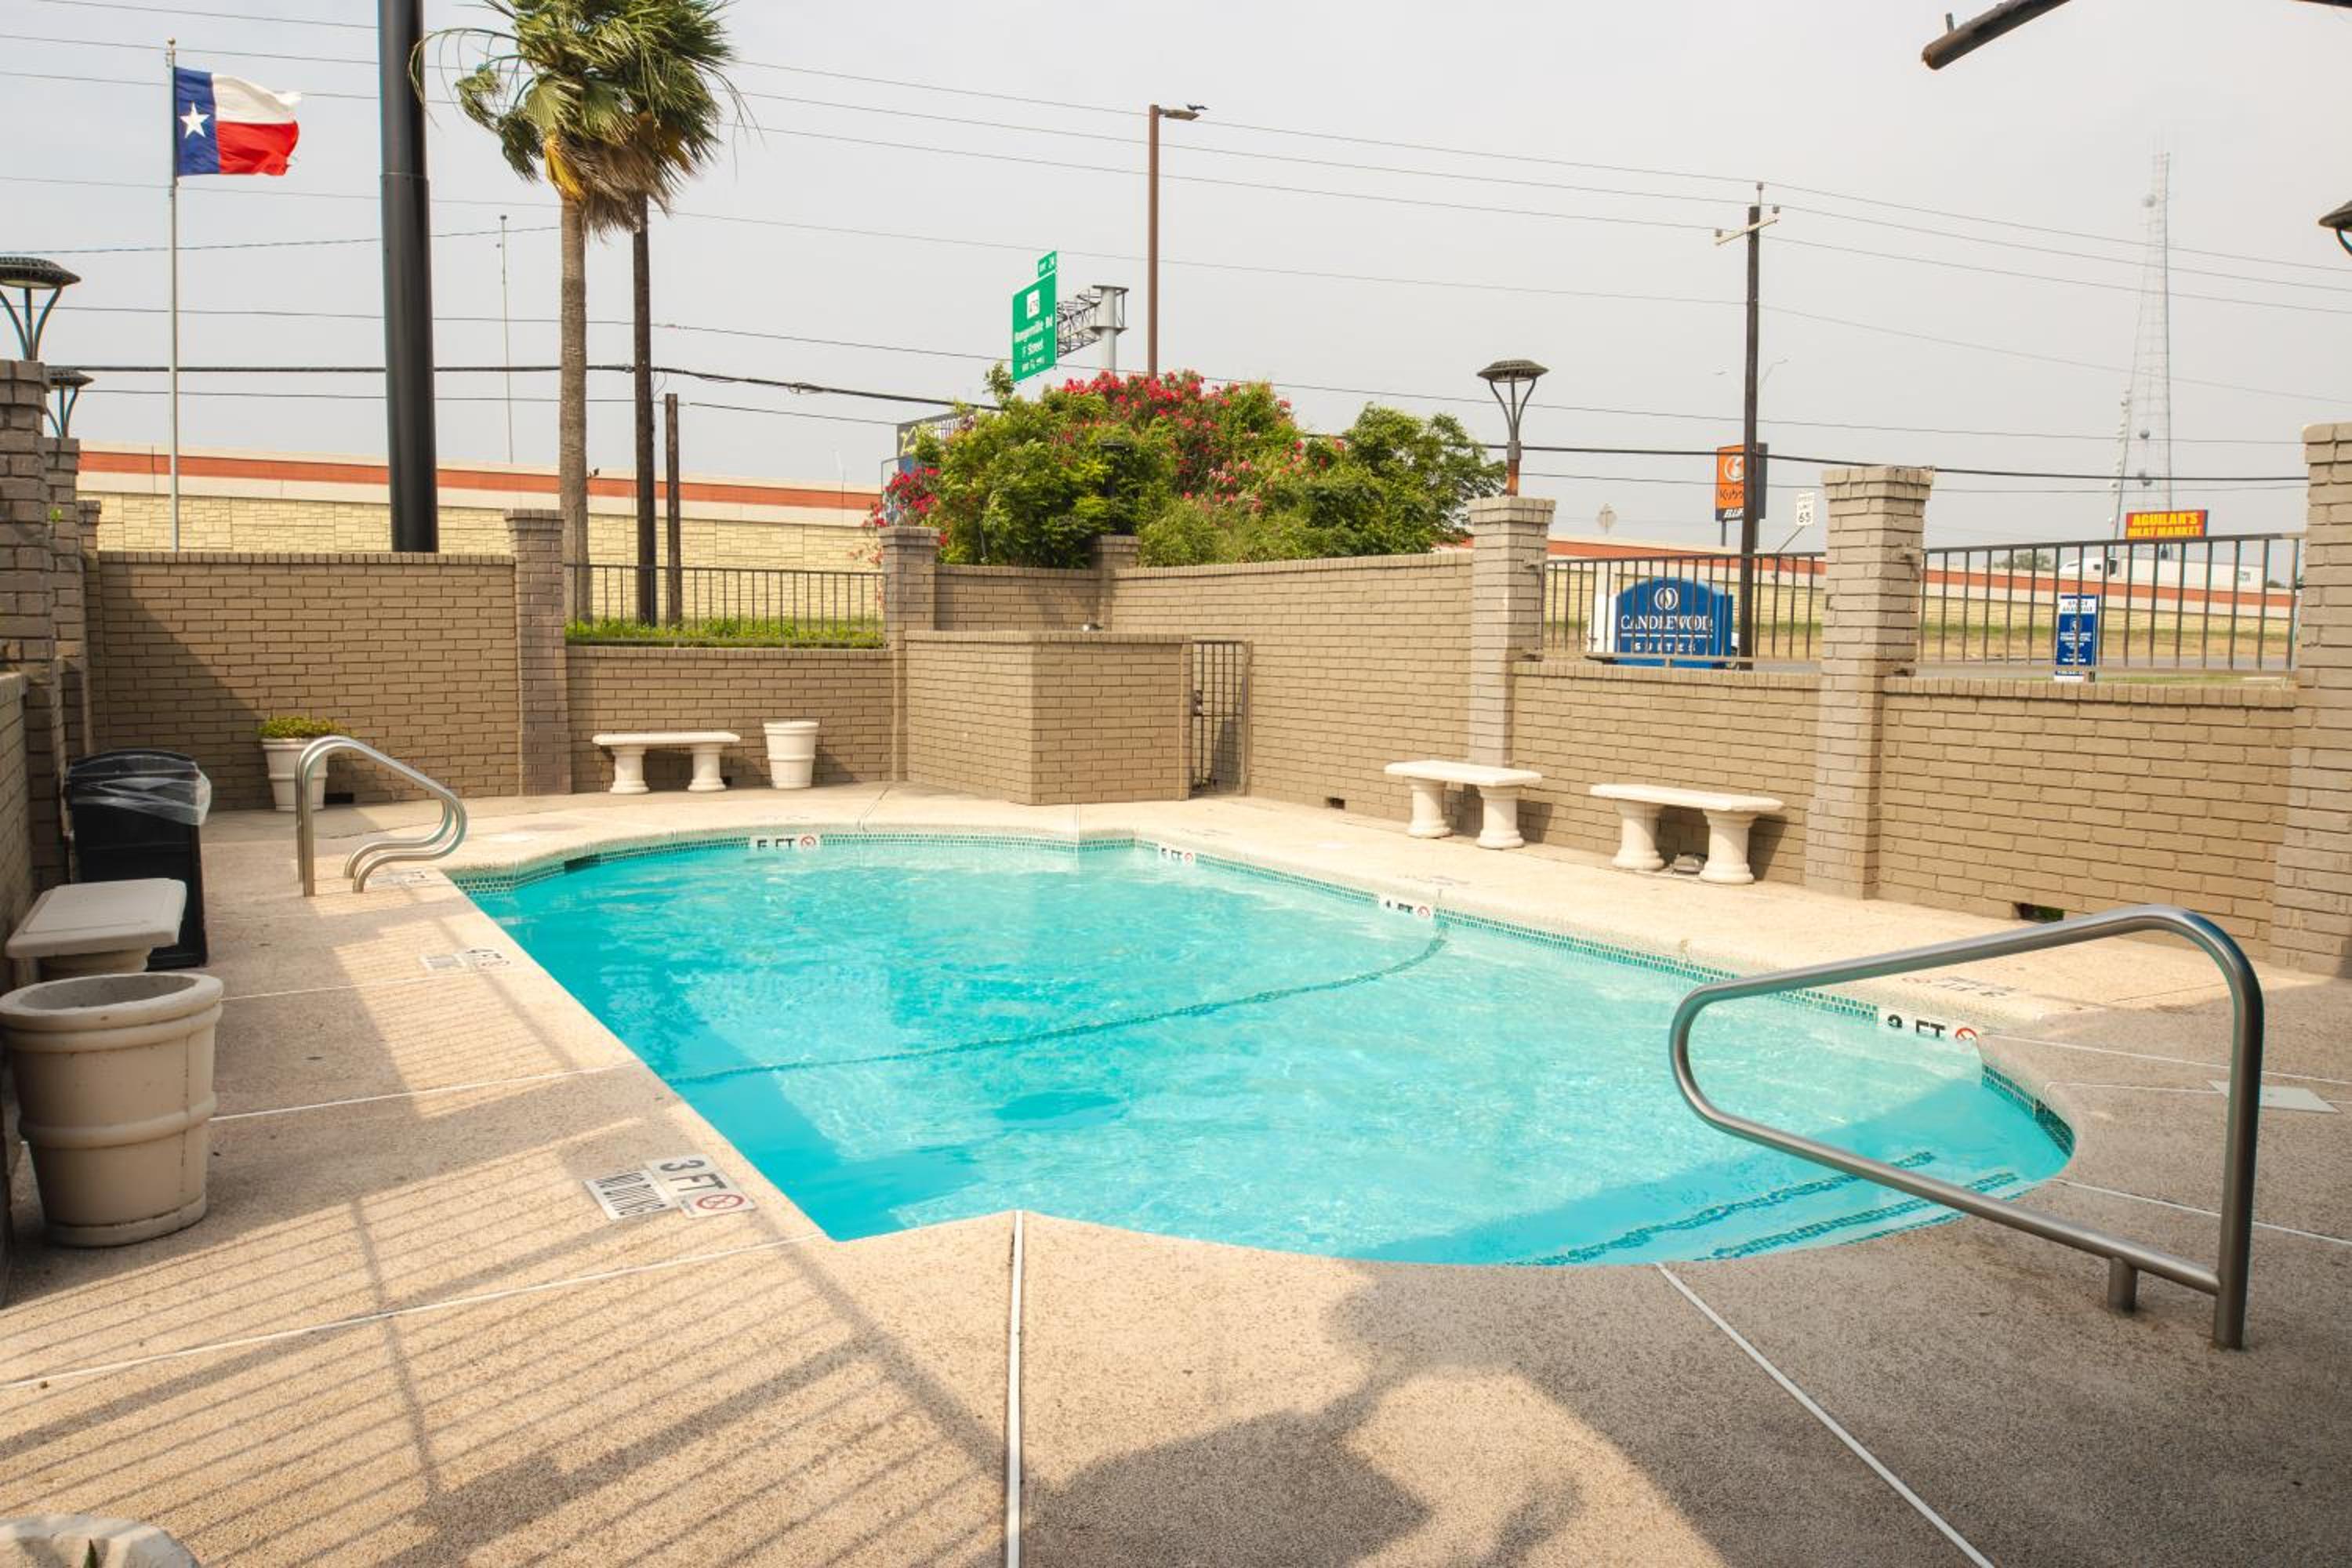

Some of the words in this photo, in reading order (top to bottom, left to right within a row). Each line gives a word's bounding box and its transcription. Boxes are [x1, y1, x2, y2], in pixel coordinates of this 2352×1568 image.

[1719, 489, 1744, 500] Kubo
[1798, 512, 1811, 522] 65
[2132, 513, 2198, 526] AGUILAR'S
[2127, 526, 2155, 538] MEAT
[2157, 526, 2201, 538] MARKET
[659, 1160, 706, 1172] 3
[668, 1173, 728, 1192] FT
